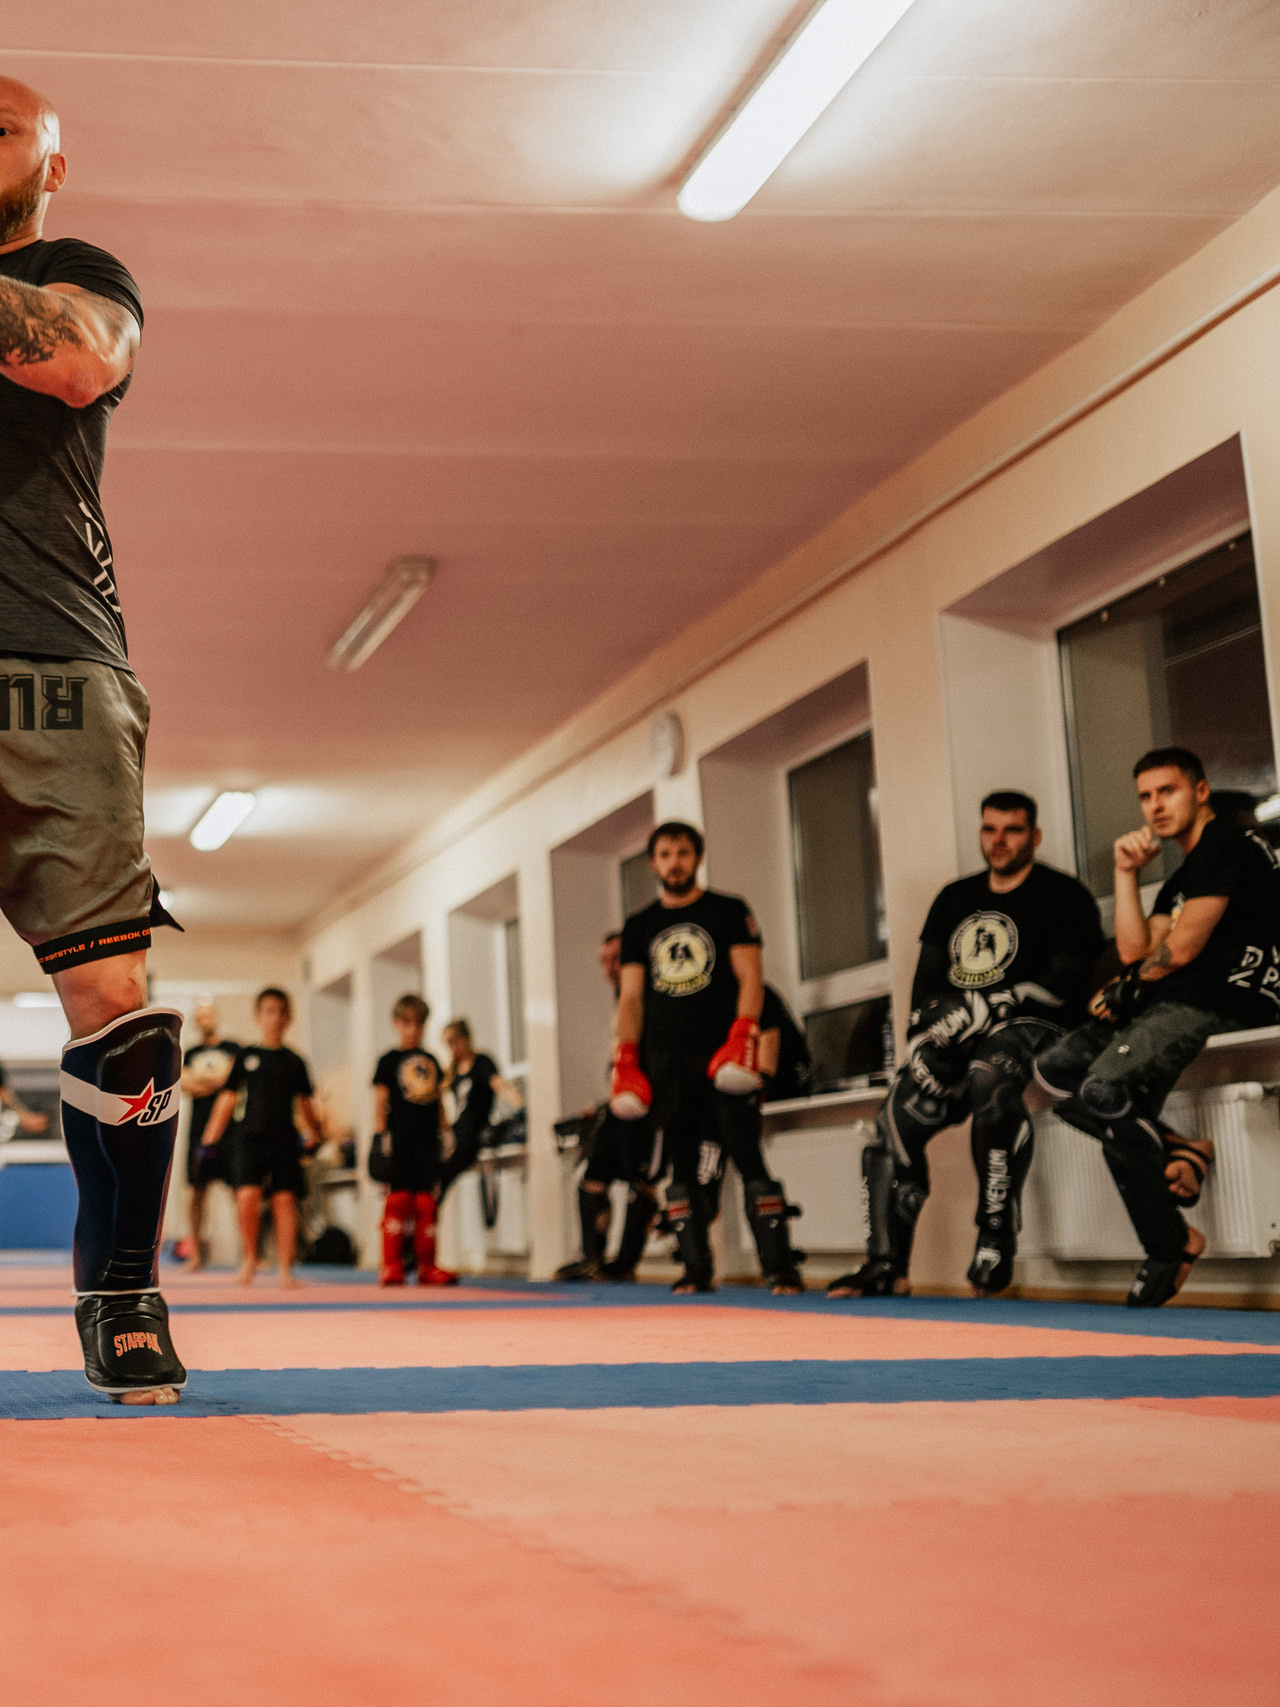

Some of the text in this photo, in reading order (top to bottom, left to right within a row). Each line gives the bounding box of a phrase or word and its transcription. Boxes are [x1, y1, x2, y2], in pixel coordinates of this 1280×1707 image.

[98, 930, 141, 946] REEBOK
[139, 1089, 173, 1124] SP
[985, 1148, 1011, 1214] VENUM
[113, 1331, 163, 1357] STARPAK
